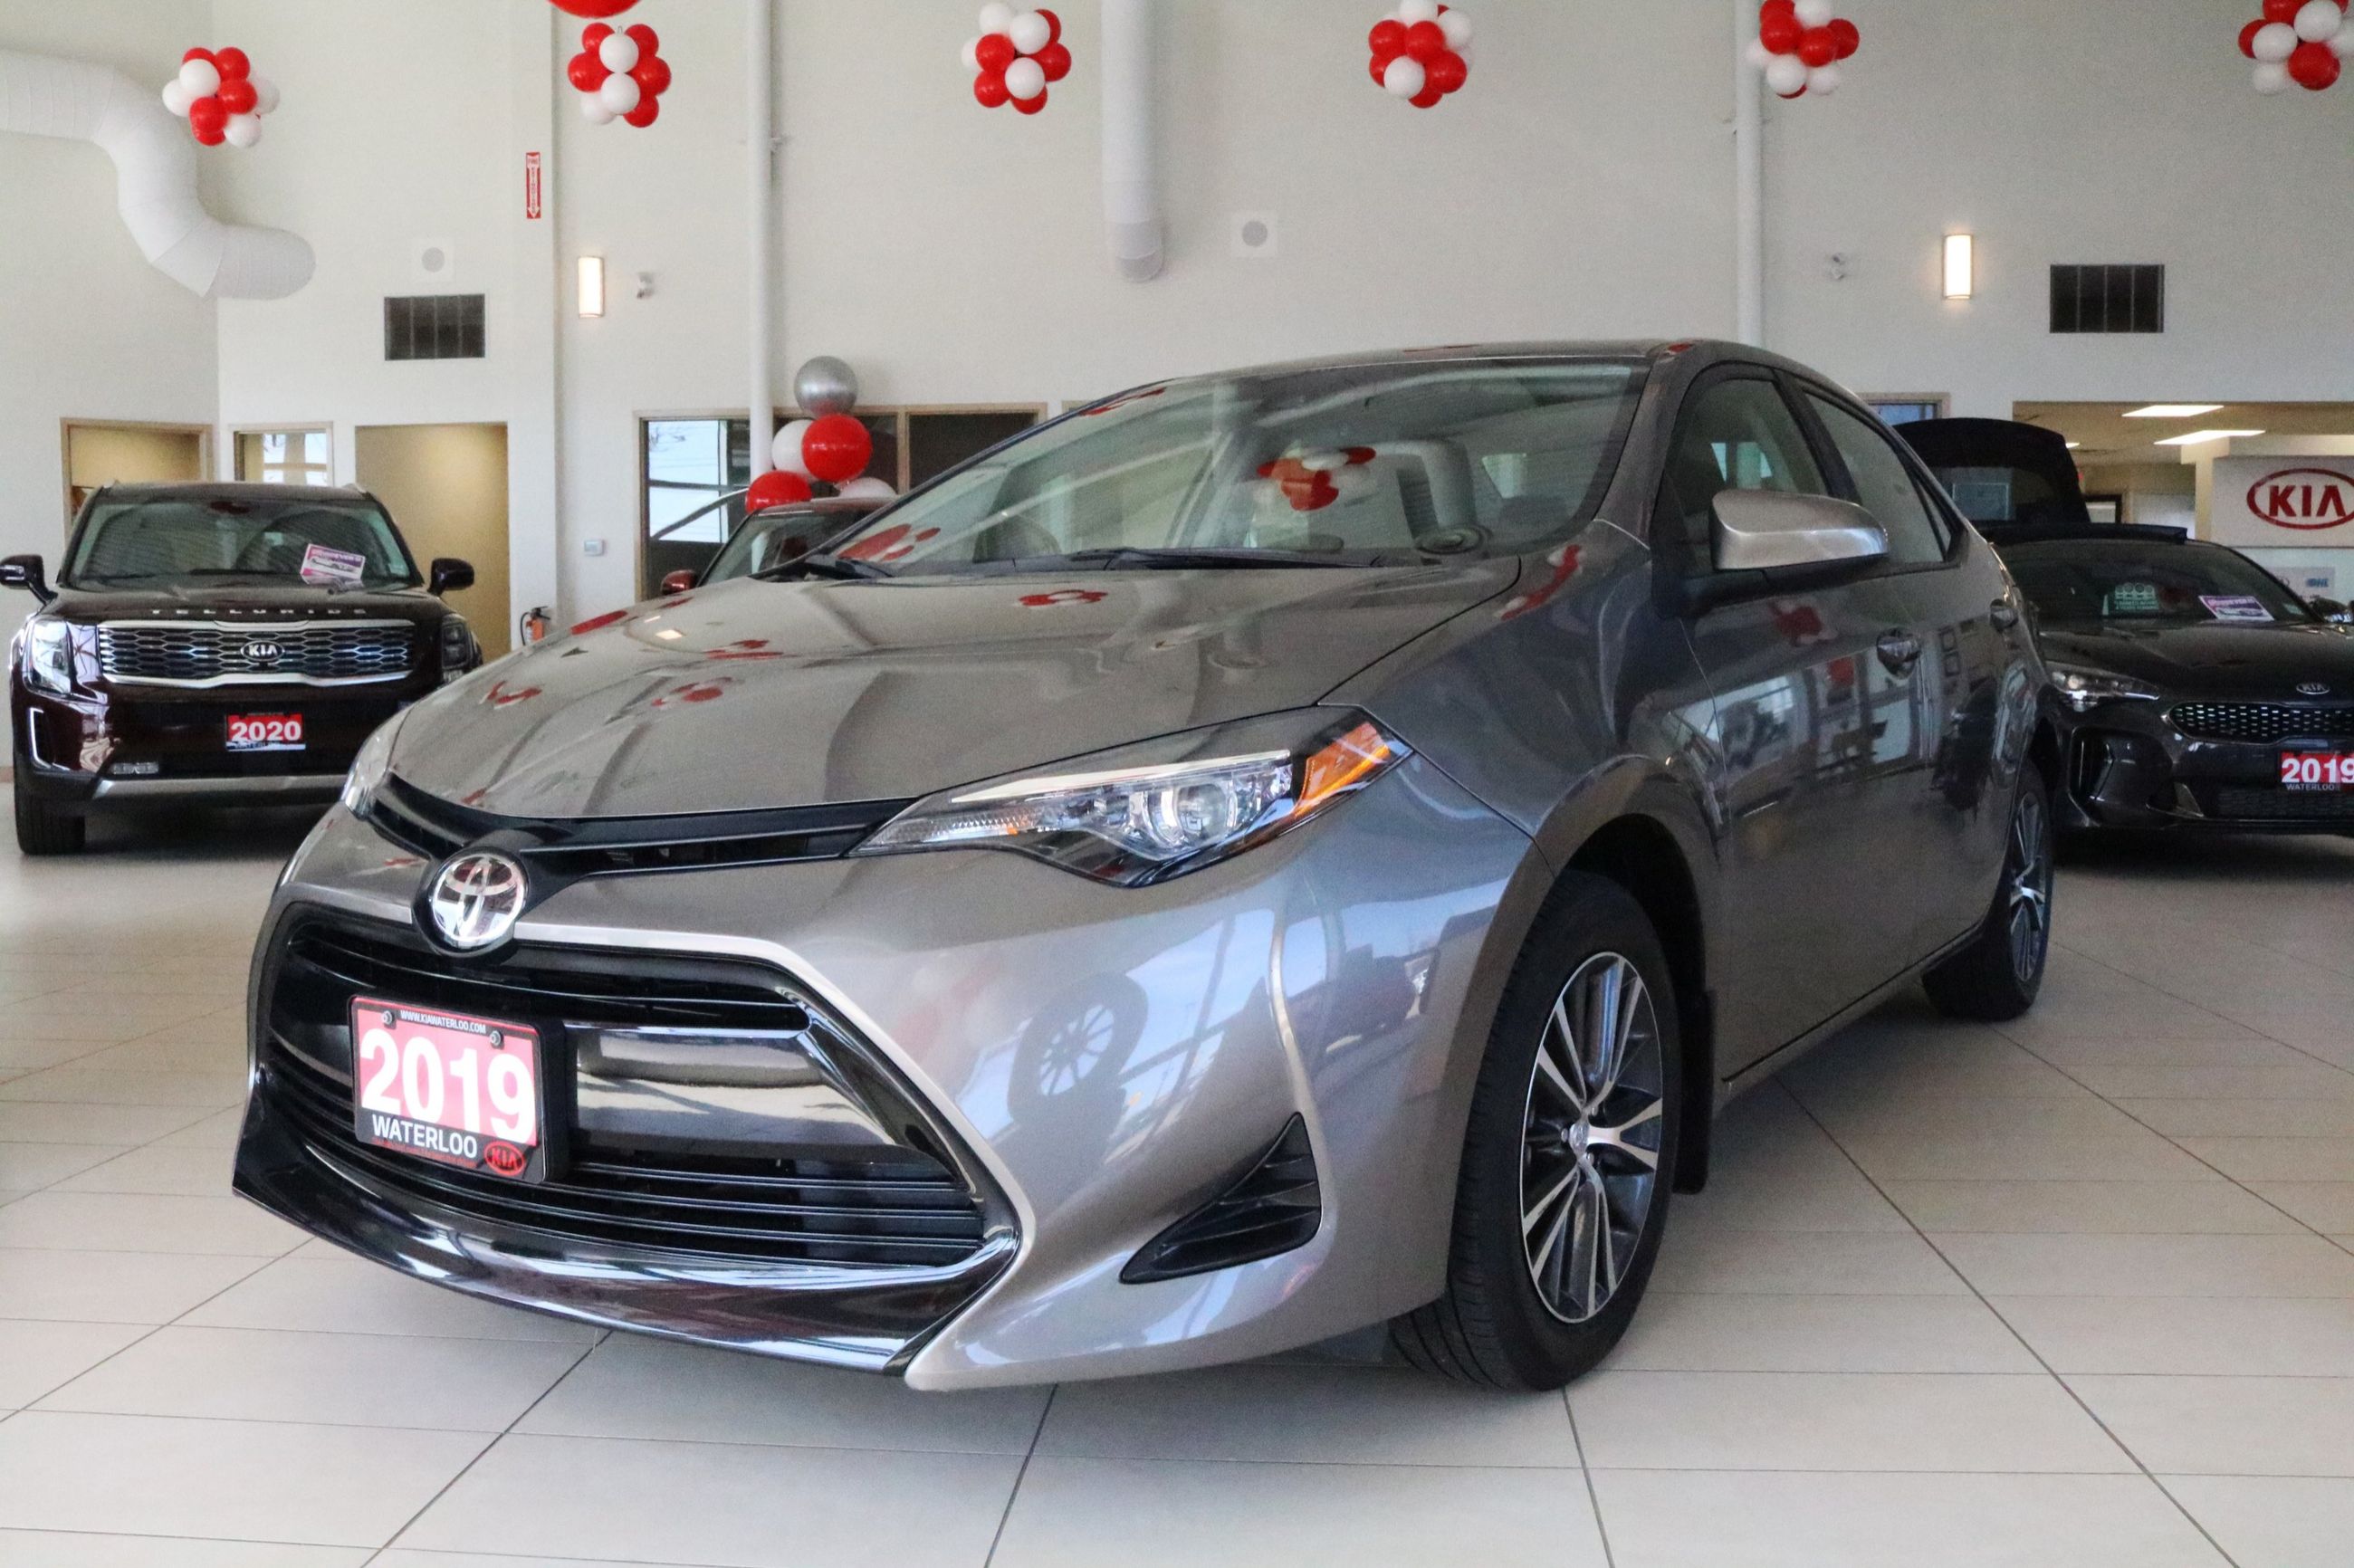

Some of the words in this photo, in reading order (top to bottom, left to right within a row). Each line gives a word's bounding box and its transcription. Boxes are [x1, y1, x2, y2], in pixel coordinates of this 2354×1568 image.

[2269, 485, 2347, 517] KIA
[248, 644, 278, 657] KIA
[231, 721, 301, 741] 2020
[2282, 758, 2354, 784] 2019
[2286, 783, 2335, 791] WATERLOO
[400, 1009, 487, 1034] WWW.KIAWATERLOO.COM
[360, 1028, 535, 1144] 2019
[372, 1114, 478, 1159] WATERLOO
[491, 1147, 517, 1169] KIA
